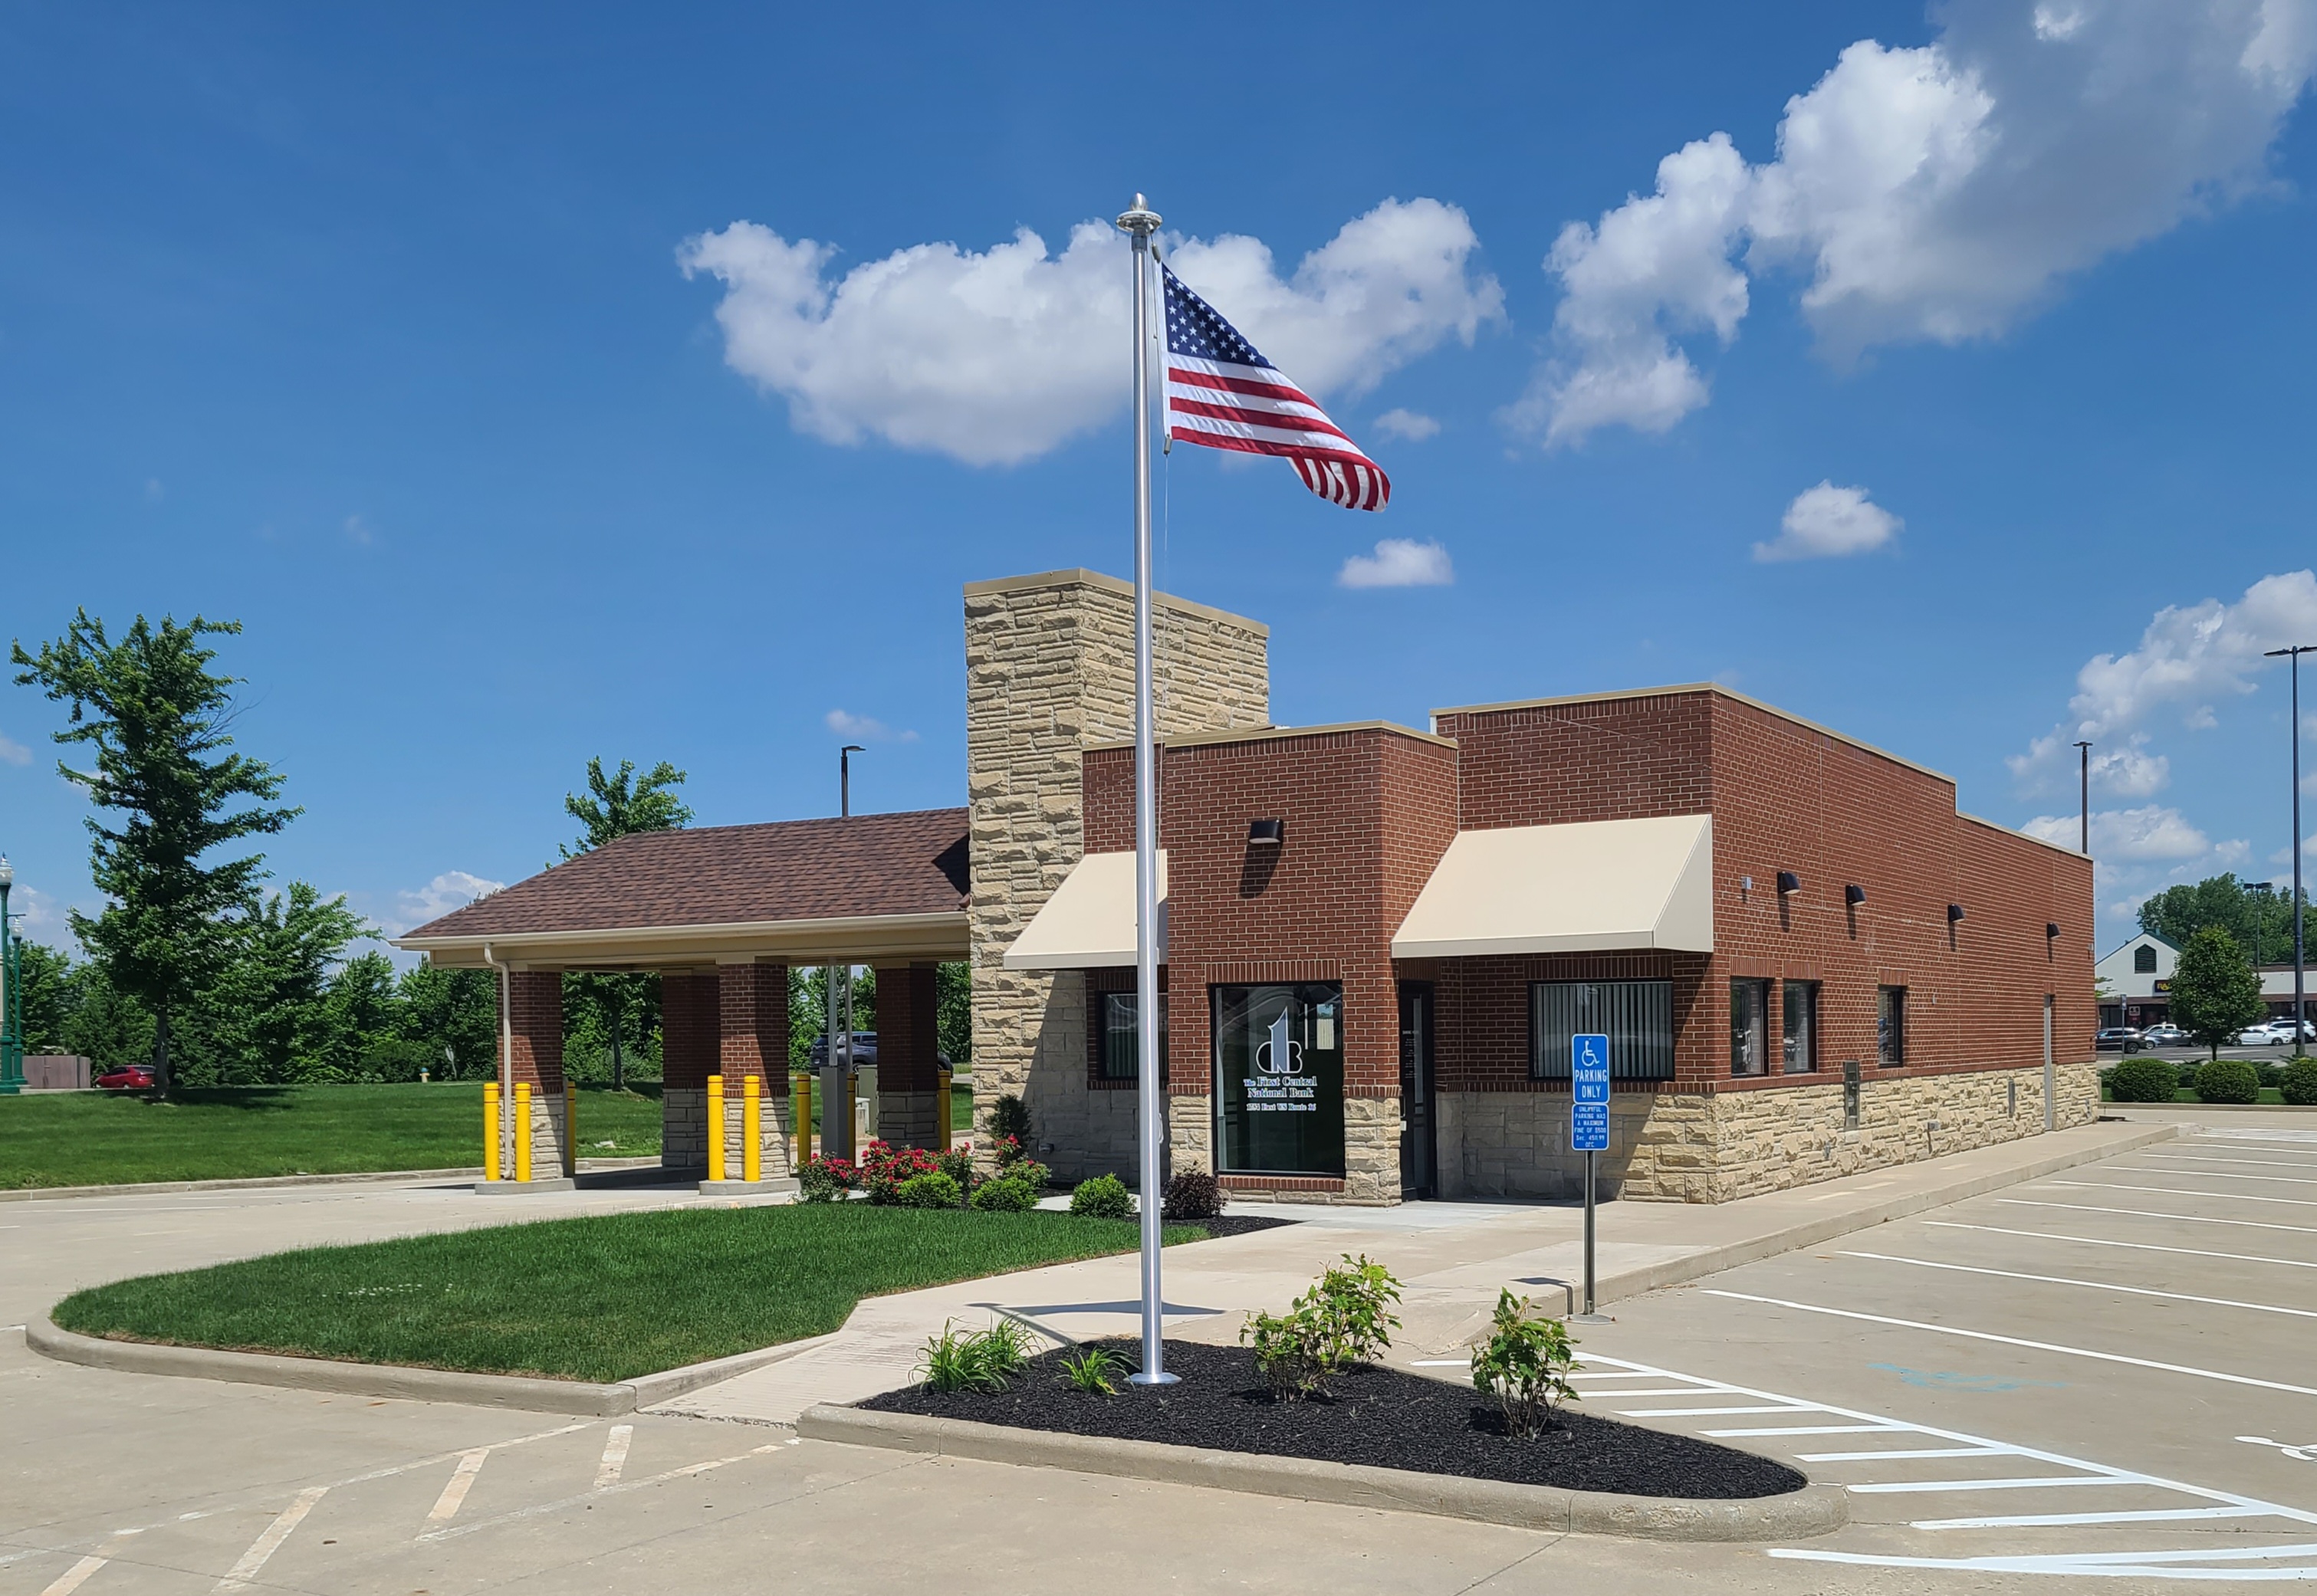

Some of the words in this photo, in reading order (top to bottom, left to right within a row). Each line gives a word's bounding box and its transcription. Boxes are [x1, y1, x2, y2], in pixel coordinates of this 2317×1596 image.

[1243, 1079, 1256, 1087] The
[1257, 1076, 1280, 1087] First
[1282, 1075, 1318, 1087] Central
[1575, 1069, 1607, 1082] PARKING
[1247, 1087, 1287, 1098] National
[1289, 1087, 1314, 1098] Bank
[1582, 1085, 1601, 1098] ONLY
